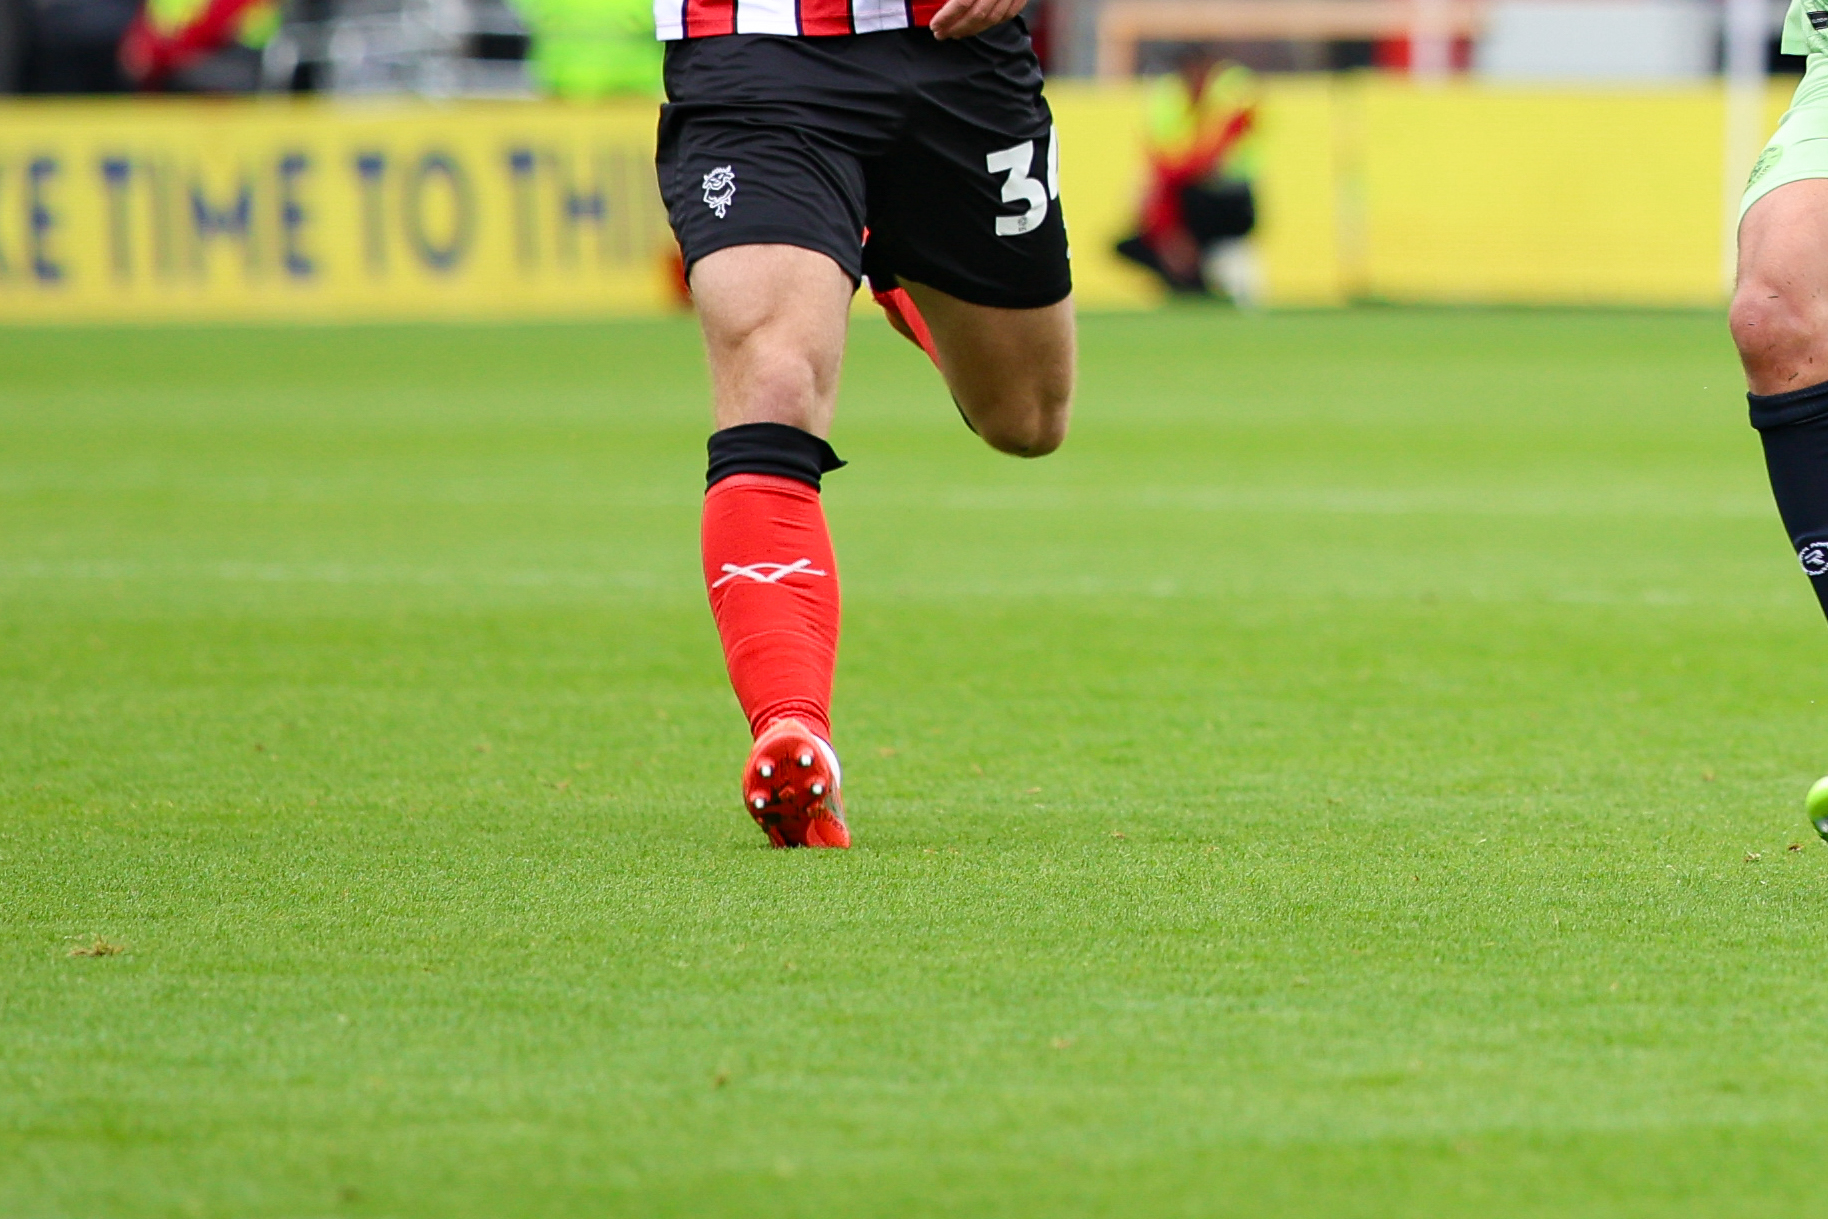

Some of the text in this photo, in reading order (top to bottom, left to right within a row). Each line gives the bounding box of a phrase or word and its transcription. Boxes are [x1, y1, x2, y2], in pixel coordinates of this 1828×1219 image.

[98, 154, 322, 283] TIME
[352, 150, 480, 275] TO
[985, 124, 1060, 237] 3
